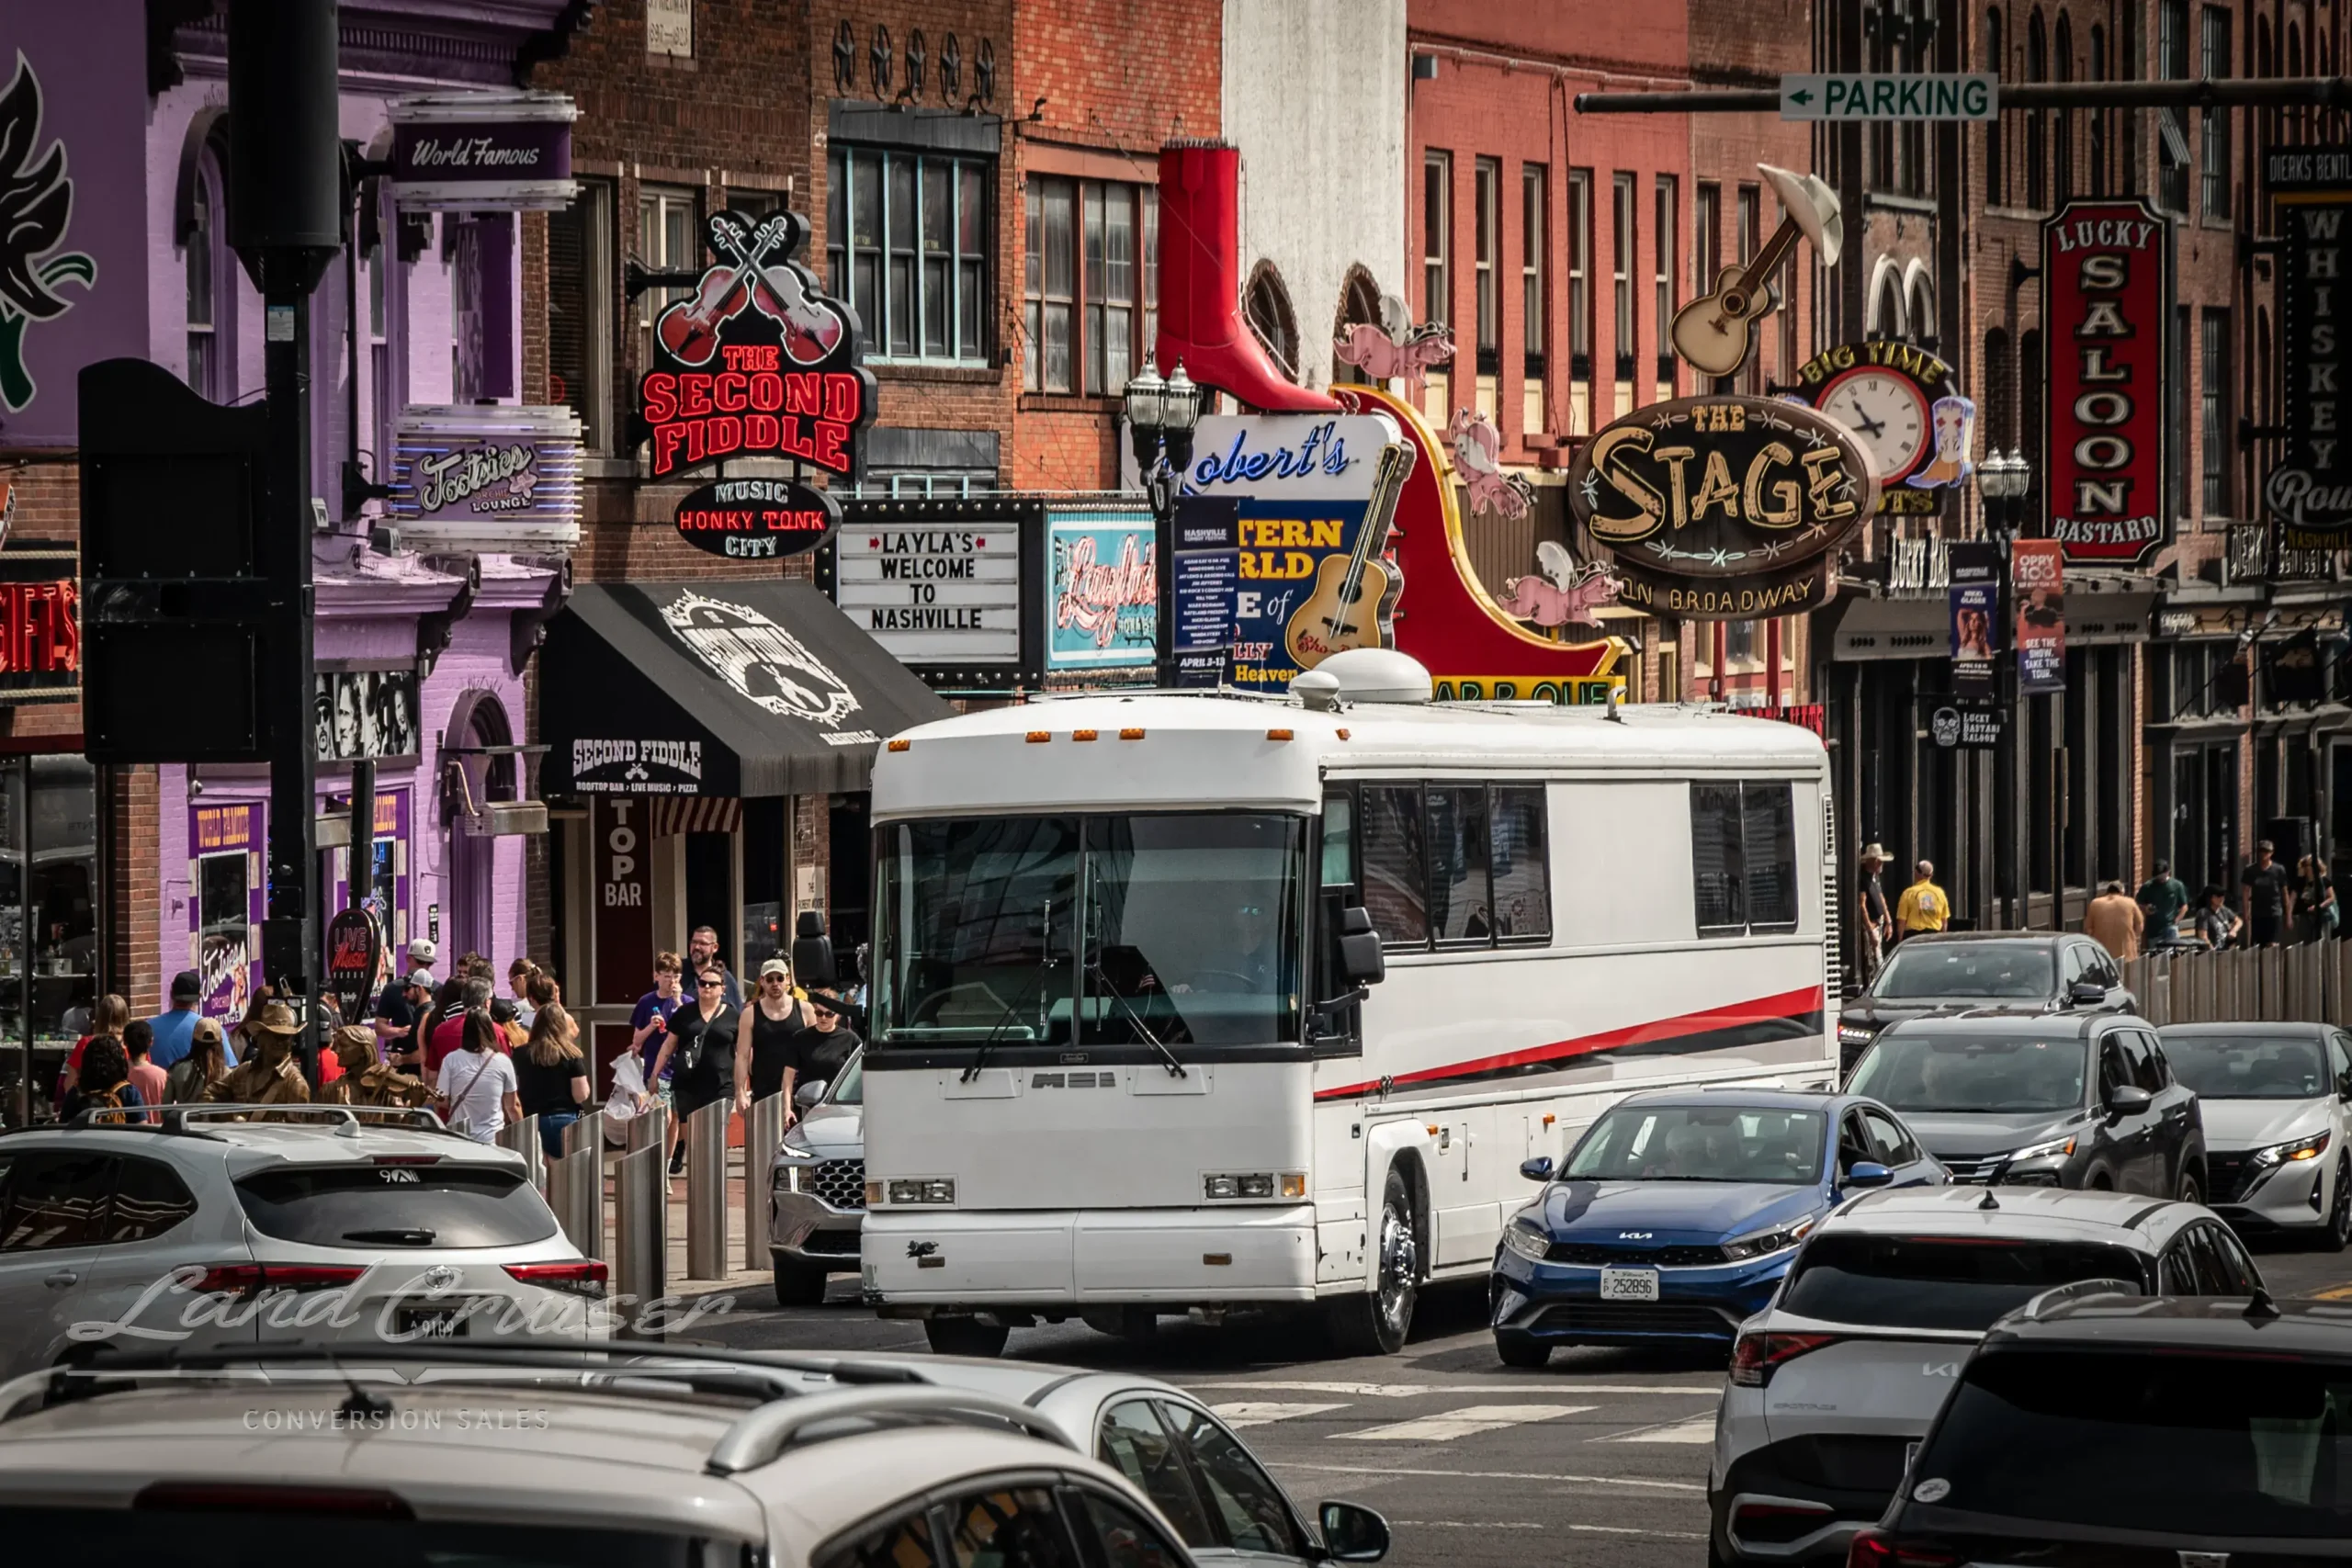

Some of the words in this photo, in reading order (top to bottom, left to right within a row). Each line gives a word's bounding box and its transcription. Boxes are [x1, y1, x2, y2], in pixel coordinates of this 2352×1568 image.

[1825, 79, 1988, 116] PARKING
[412, 139, 473, 166] World
[474, 137, 540, 166] Famous
[2269, 154, 2312, 182] DIERKS
[2055, 220, 2155, 253] LUCKY
[2301, 209, 2345, 470] WHISKEY
[722, 345, 780, 371] THE
[1801, 345, 1856, 385] BIG
[1865, 341, 1946, 385] TIME
[2074, 255, 2132, 513] SALOON
[644, 372, 860, 423] SECOND
[1691, 404, 1746, 433] THE
[654, 414, 850, 476] FIDDLE
[1185, 421, 1352, 496] obert's
[419, 444, 536, 513] Tootsies
[1589, 426, 1857, 542] STAGE
[714, 480, 788, 504] MUSIC
[472, 498, 531, 513] LOUNGE
[679, 511, 754, 531] HONKY
[762, 511, 826, 531] TONK
[1184, 528, 1227, 537] NASHVILLE
[2052, 515, 2158, 545] BASTARD
[725, 536, 777, 557] CITY
[882, 533, 973, 553] LAYLA'S
[880, 558, 976, 579] WELCOME
[2019, 554, 2054, 567] OPRY
[2019, 566, 2056, 581] 100
[910, 583, 936, 604] TO
[1620, 578, 1653, 606] ON
[1669, 578, 1815, 613] BROADWAY
[872, 608, 983, 629] NASHVILLE
[1267, 589, 1294, 626] of
[2026, 637, 2041, 649] SEE
[2041, 637, 2057, 648] THE
[1180, 658, 1205, 667] APRIL
[1206, 657, 1226, 667] 3-13
[1236, 665, 1298, 682] Heaven
[2024, 658, 2043, 670] TAKE
[2044, 657, 2060, 669] THE
[1962, 712, 1990, 724] LUCKY
[1962, 733, 1996, 743] SALOON
[572, 739, 636, 778] SECOND
[640, 740, 702, 780] FIDDLE
[576, 782, 608, 791] ROOFTOP
[609, 782, 625, 792] BAR
[630, 783, 646, 792] LIVE
[647, 783, 671, 793] MUSIC
[678, 784, 698, 793] PIZZA
[609, 799, 637, 882] TOP
[605, 883, 642, 907] BAR
[334, 927, 368, 952] LIVE
[202, 942, 239, 1003] Tootsies
[1612, 1278, 1653, 1294] 252896
[1923, 1362, 1960, 1378] KI
